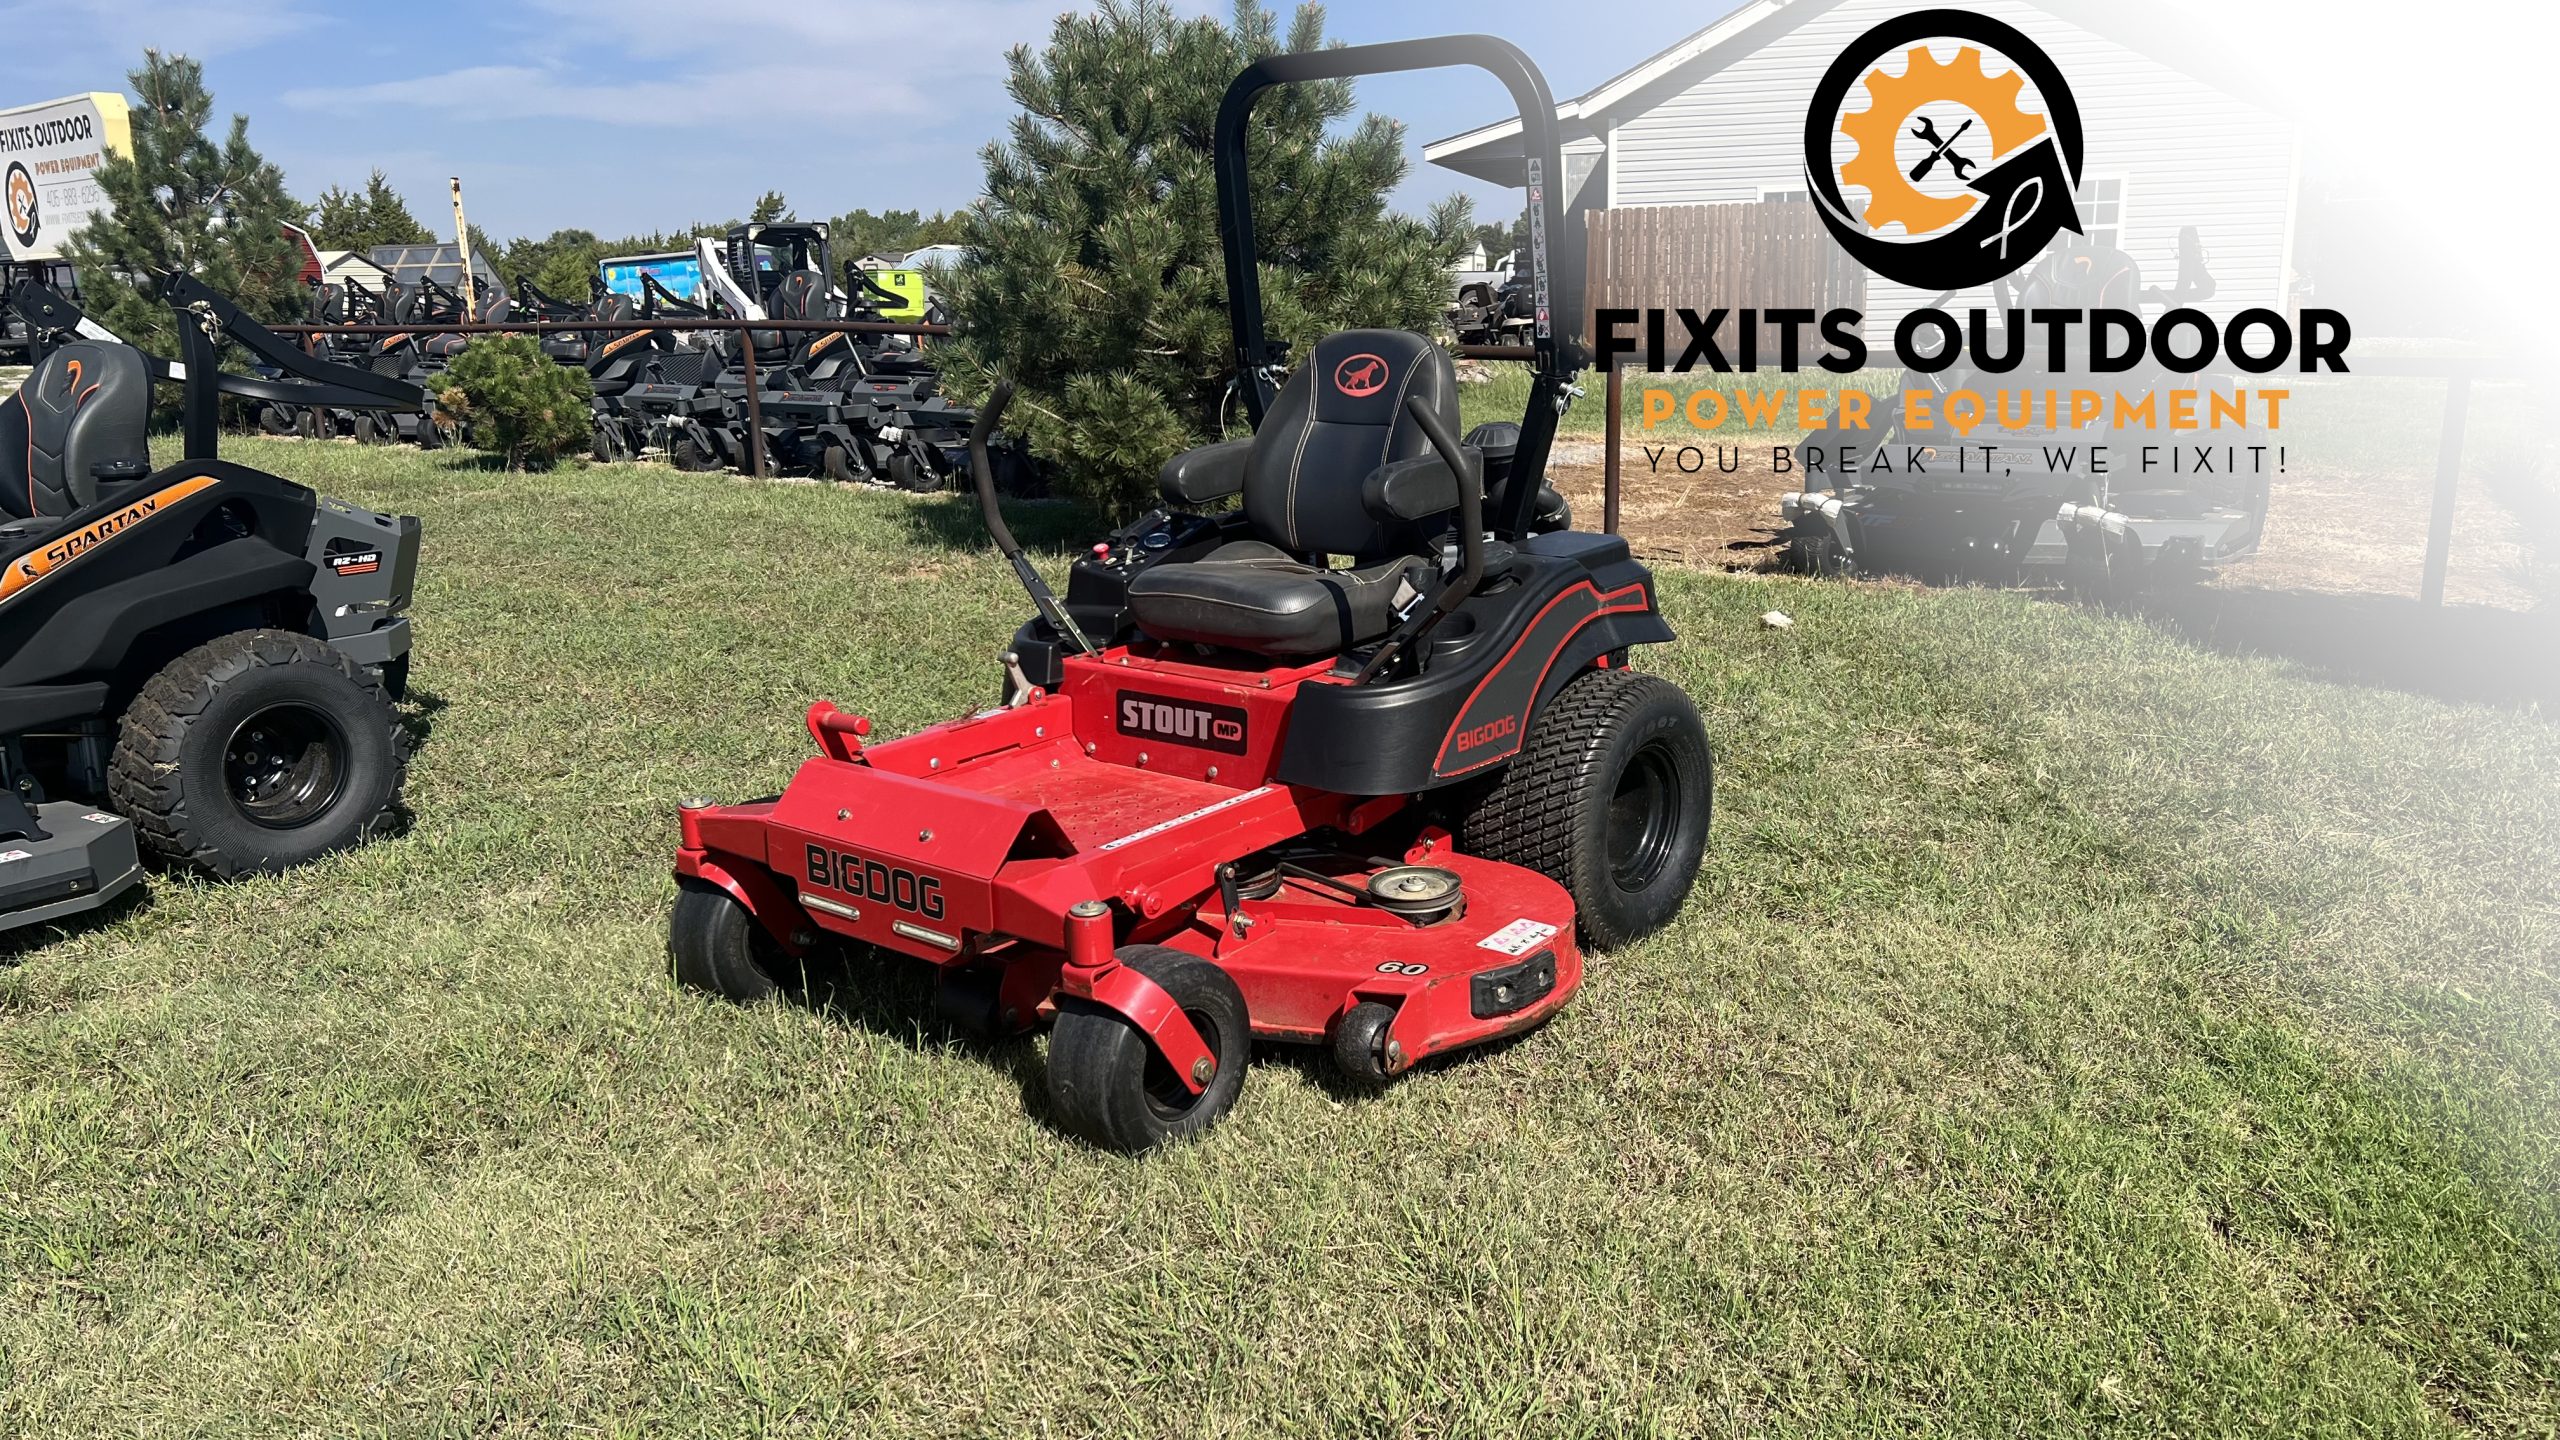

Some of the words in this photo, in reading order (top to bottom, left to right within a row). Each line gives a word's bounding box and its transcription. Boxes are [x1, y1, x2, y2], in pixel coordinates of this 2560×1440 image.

[0, 126, 33, 152] FIXITS
[34, 115, 92, 147] OUTDOOR
[34, 160, 59, 176] POWER
[60, 153, 100, 174] EQUIPMENT
[47, 499, 156, 568] SPARTAN
[1123, 699, 1212, 740] STOUT
[1218, 723, 1238, 737] MP
[1457, 715, 1516, 752] BIGDOG
[805, 843, 944, 921] BIGDOG
[1376, 960, 1429, 976] 60
